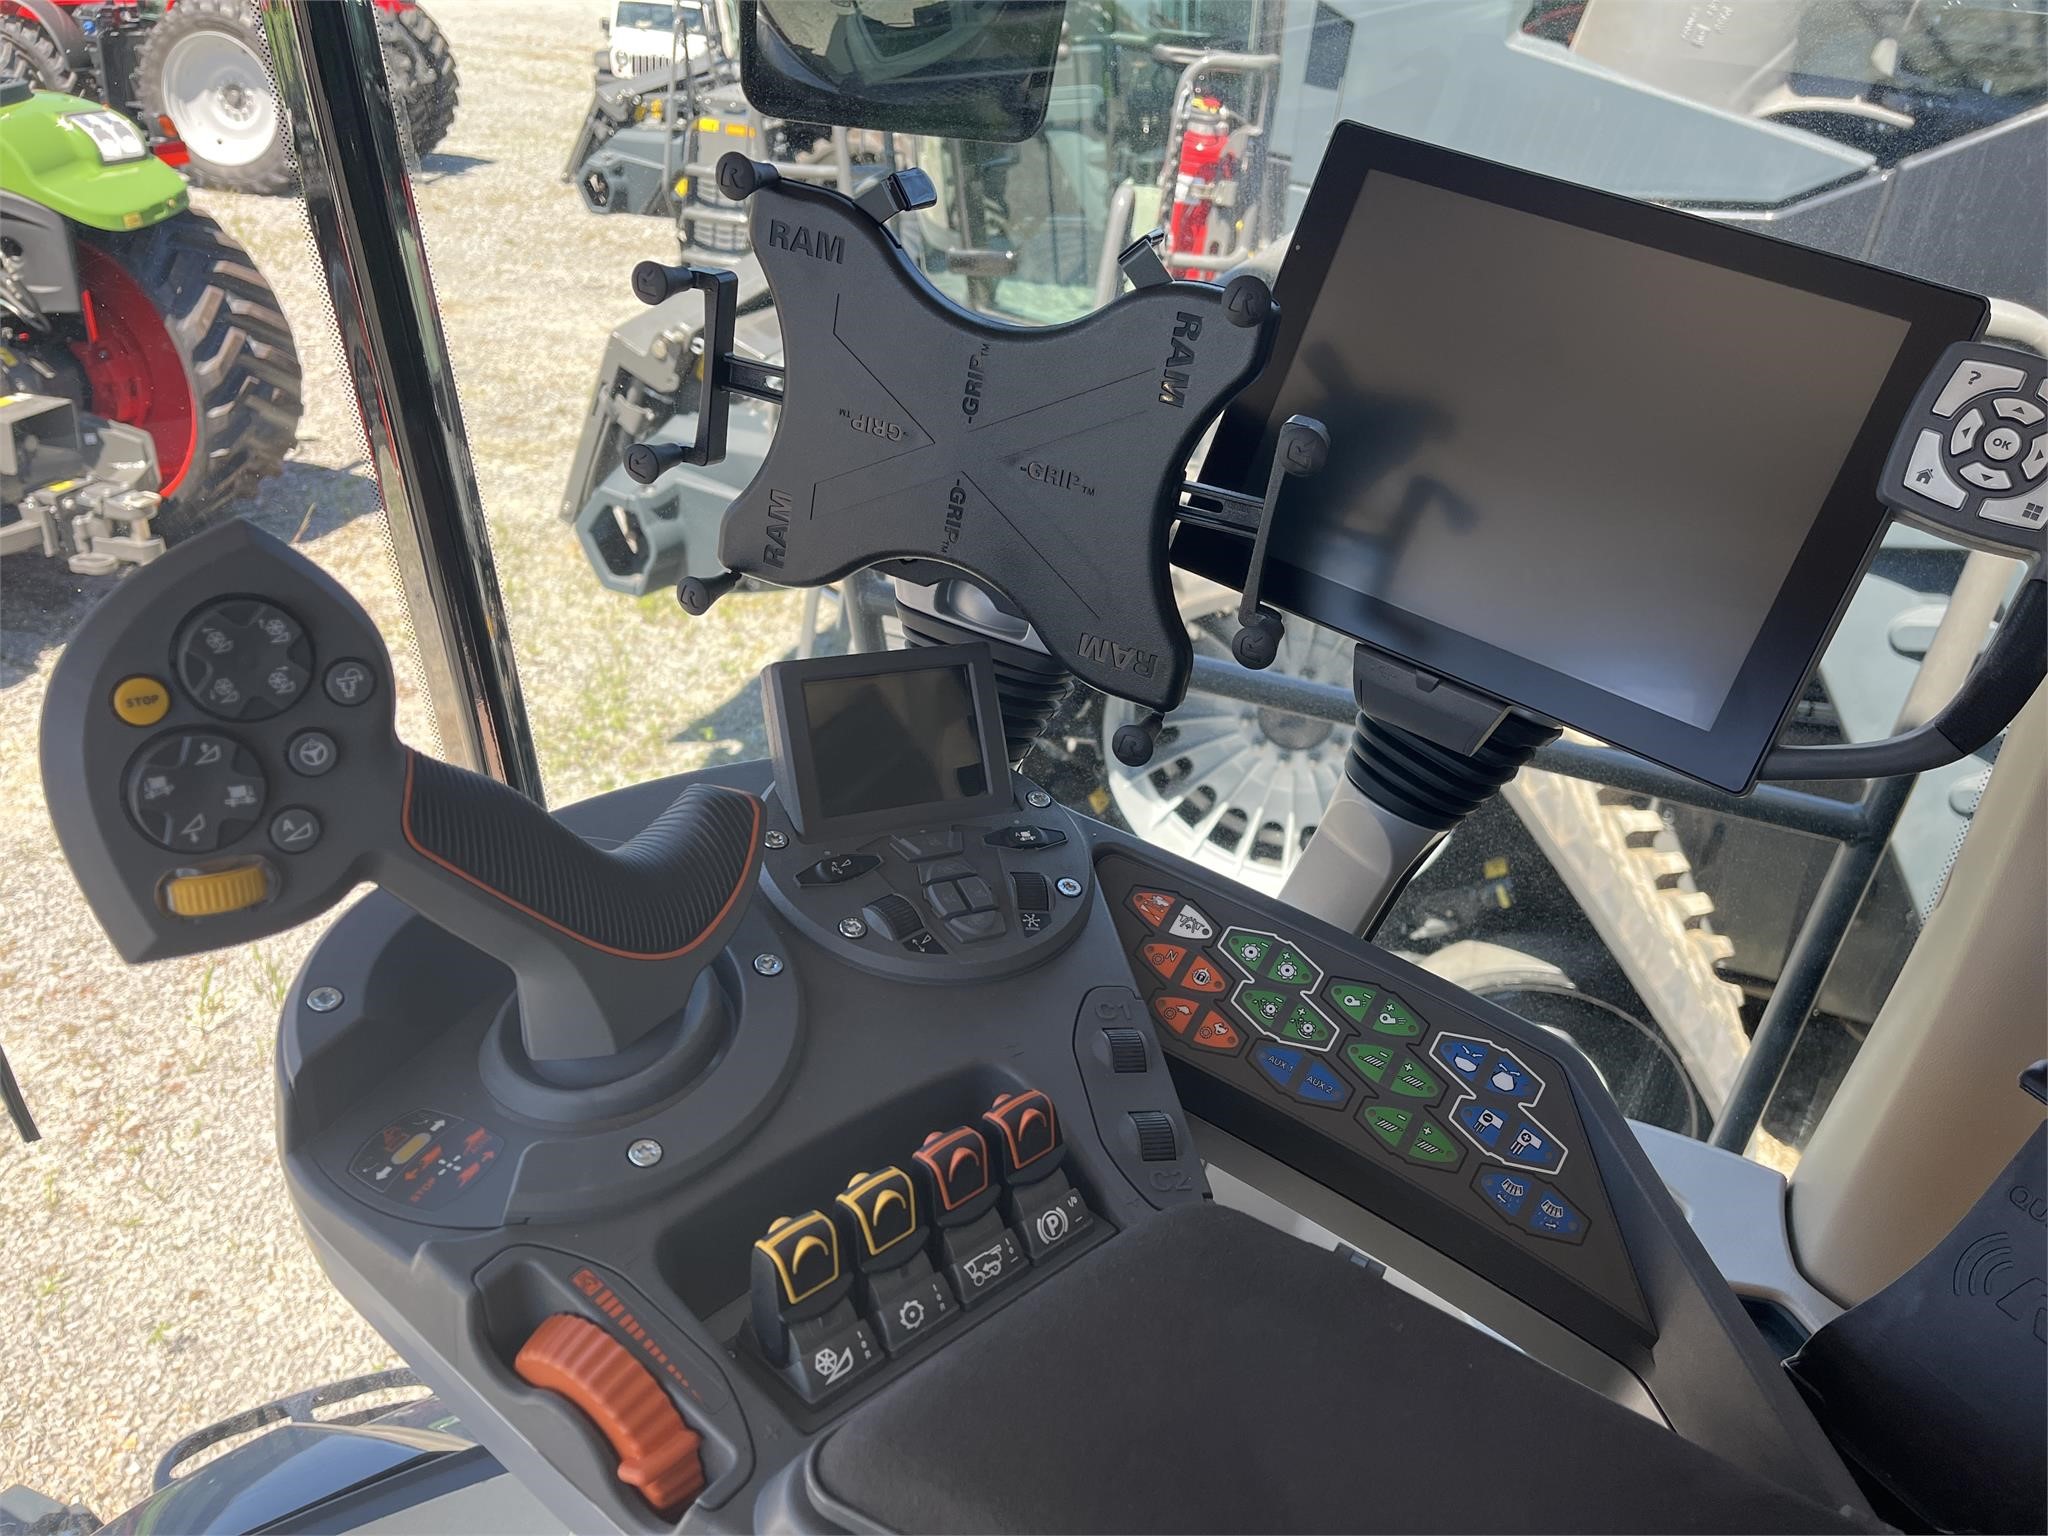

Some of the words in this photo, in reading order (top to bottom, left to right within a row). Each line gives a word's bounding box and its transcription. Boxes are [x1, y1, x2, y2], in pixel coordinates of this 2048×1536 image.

[769, 219, 846, 265] RAM
[1158, 311, 1203, 409] RAM
[1992, 438, 2012, 450] OK
[763, 488, 793, 569] RAM
[1078, 632, 1158, 679] RAM
[125, 694, 160, 708] STOP
[1165, 949, 1178, 963] N
[1096, 1003, 1132, 1021] C1
[1268, 1055, 1287, 1070] AUX
[1306, 1075, 1325, 1091] AUX
[1325, 1086, 1334, 1094] 2
[1149, 1169, 1193, 1193] C2
[1046, 1214, 1059, 1237] P
